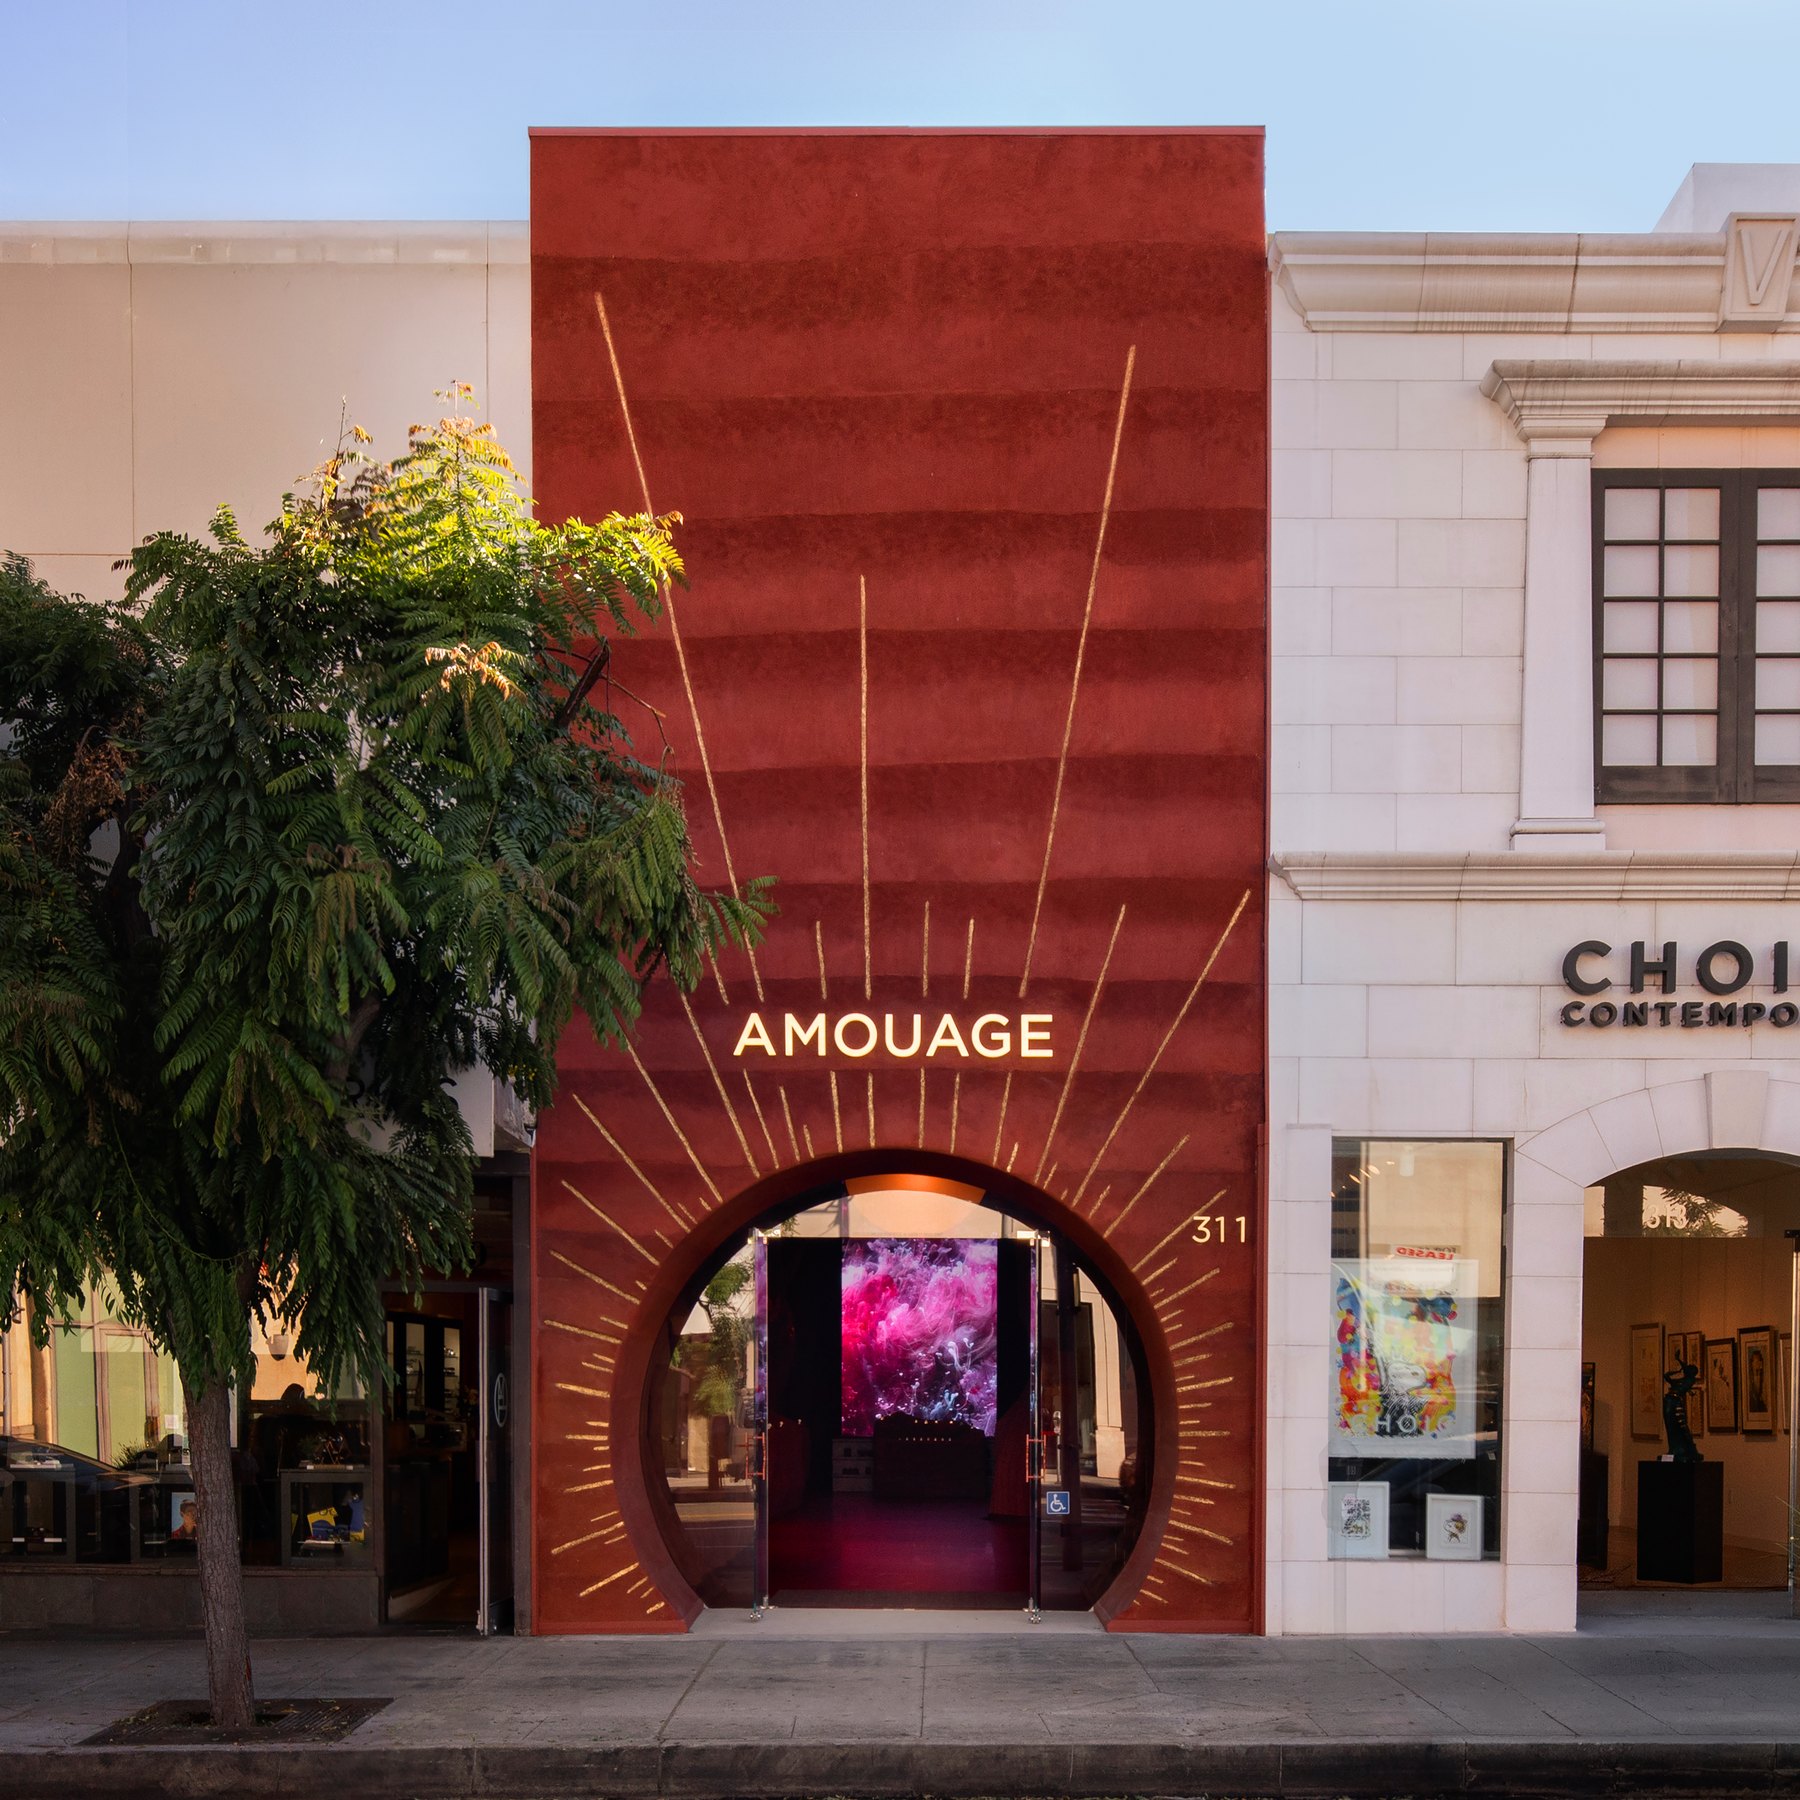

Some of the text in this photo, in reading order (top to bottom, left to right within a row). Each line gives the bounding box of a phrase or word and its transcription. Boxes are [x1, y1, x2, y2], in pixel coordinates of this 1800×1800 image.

[1562, 940, 1788, 995] CHOI
[1561, 1001, 1800, 1028] CONTEMPO
[733, 1012, 1053, 1057] AMOUAGE
[1192, 1216, 1246, 1243] 311
[1646, 1204, 1687, 1229] 313
